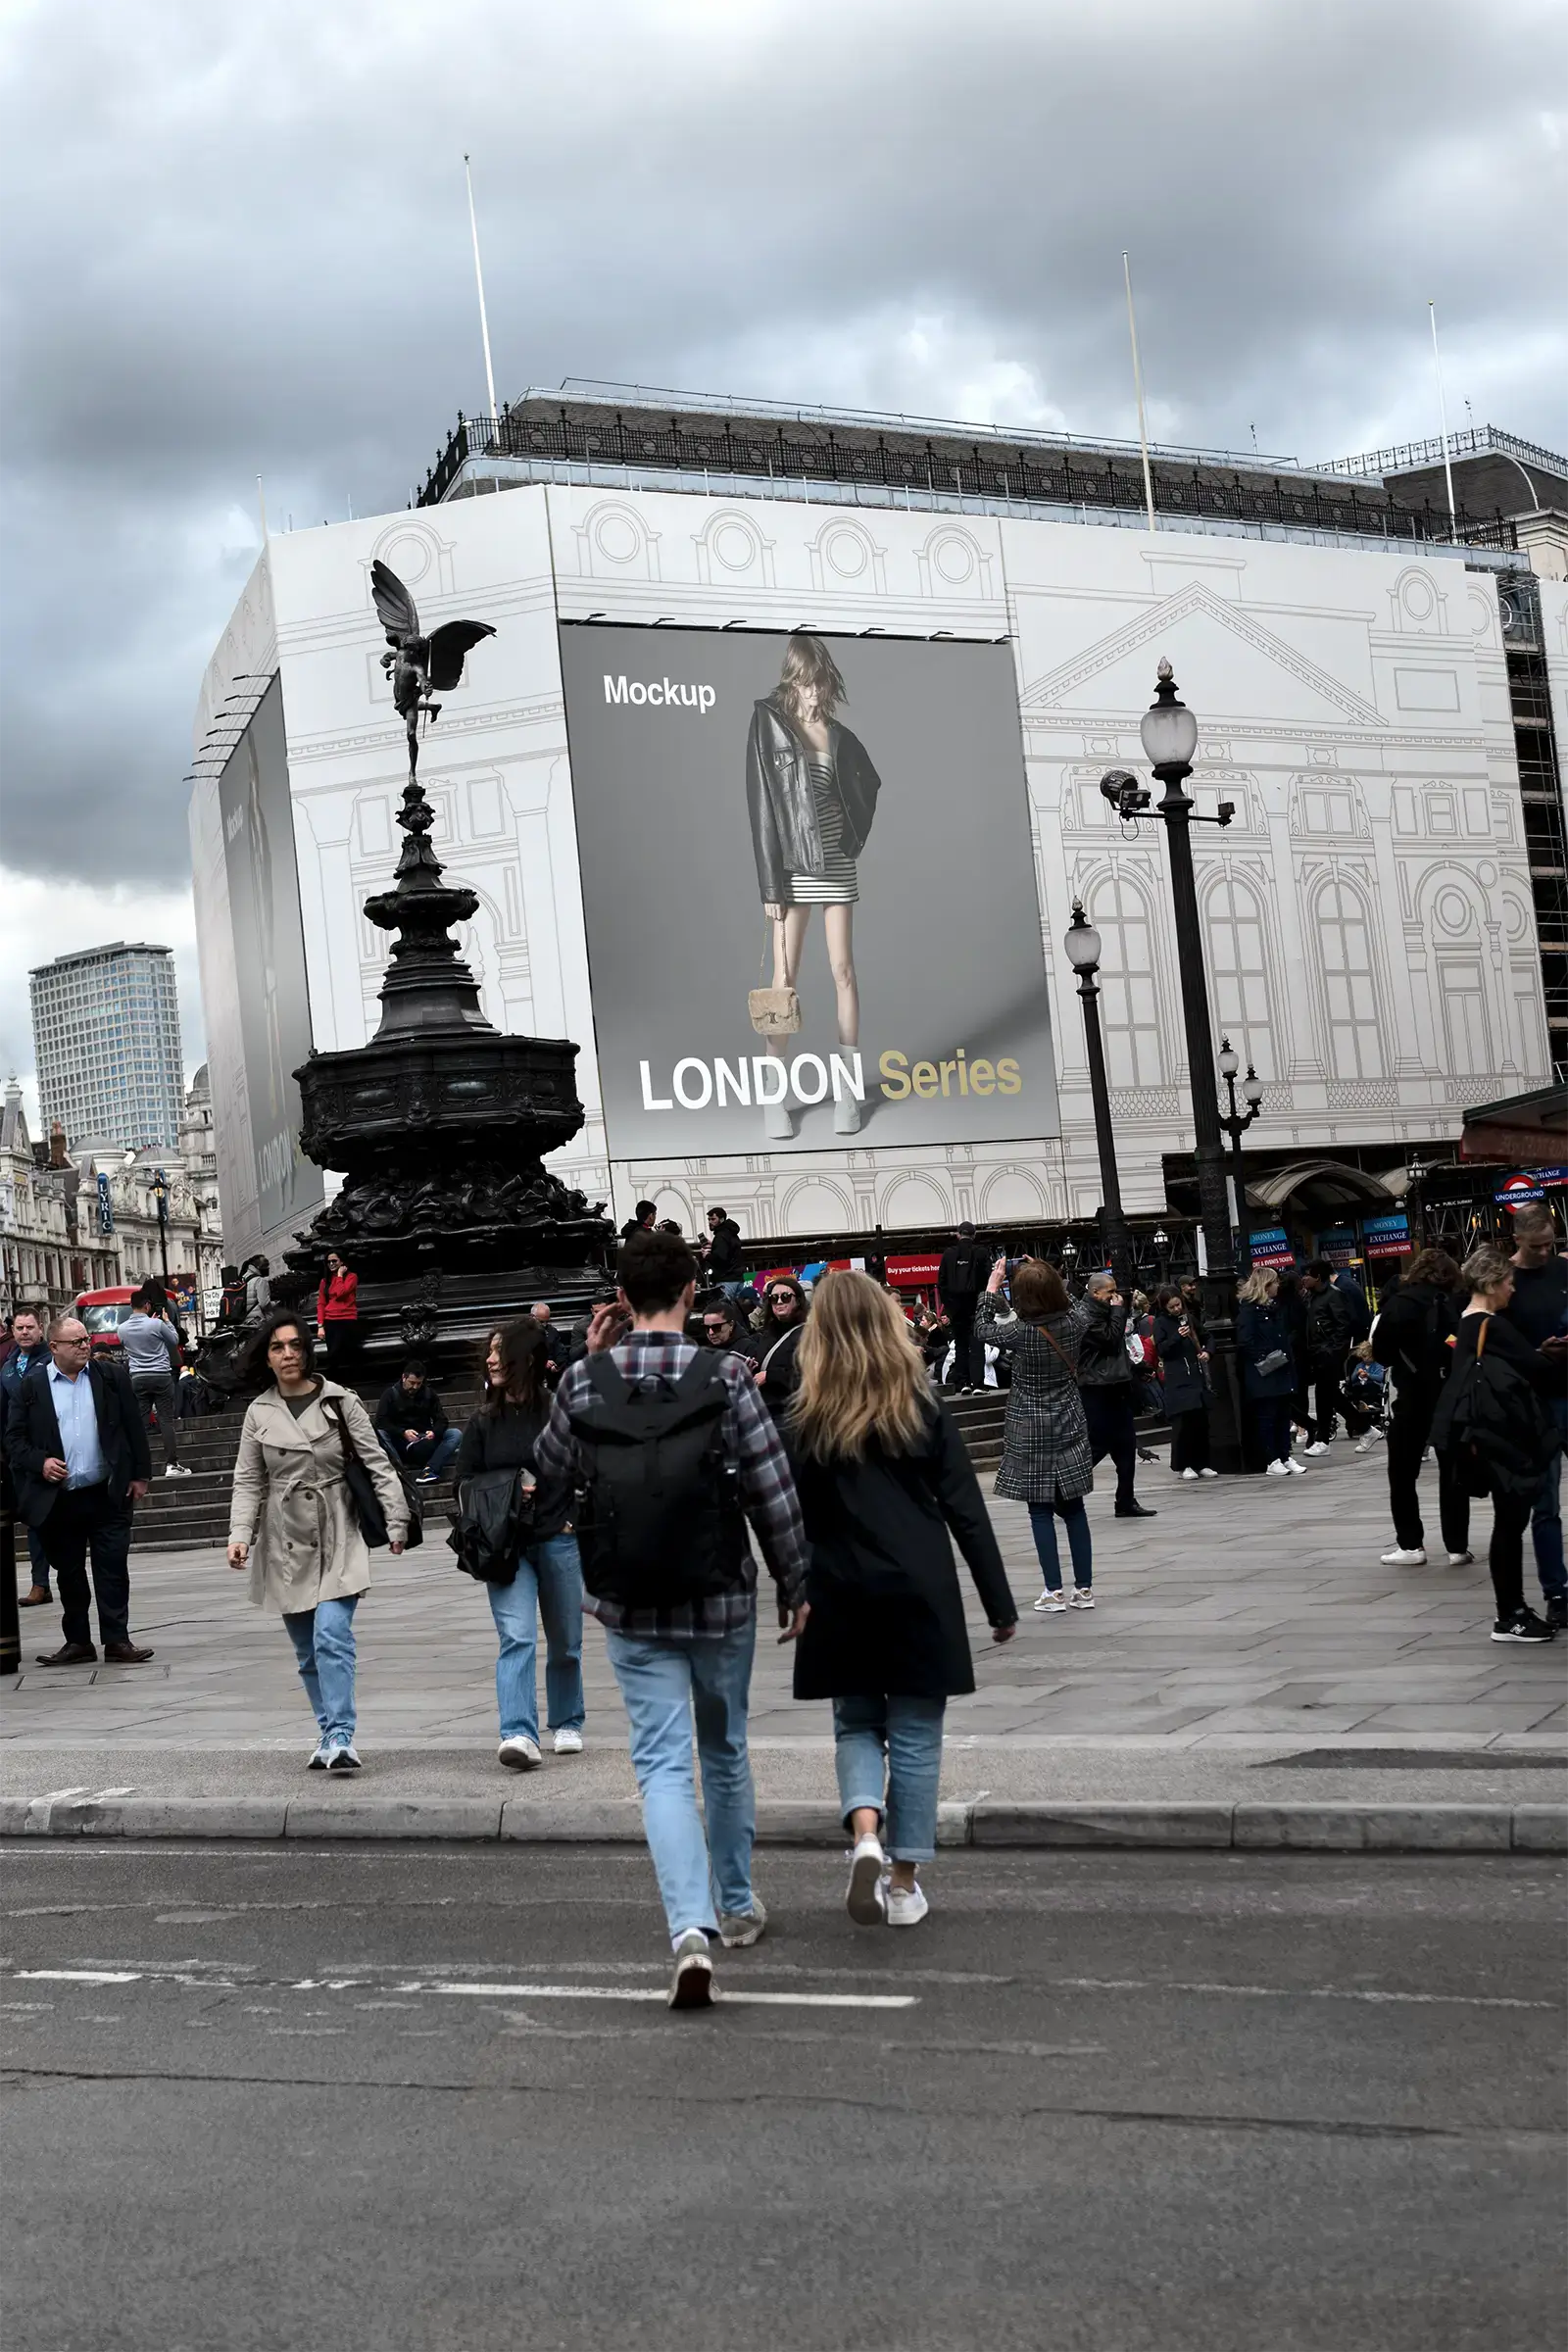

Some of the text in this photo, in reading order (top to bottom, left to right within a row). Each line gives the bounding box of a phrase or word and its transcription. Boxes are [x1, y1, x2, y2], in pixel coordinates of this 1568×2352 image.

[604, 675, 716, 713] Mockup
[226, 804, 243, 844] Mockup
[639, 1049, 1022, 1110] LONDON Series
[258, 1124, 293, 1193] LONDON
[99, 1183, 112, 1230] LYRIC
[1494, 1190, 1544, 1201] UNDERGROUND
[1252, 1232, 1276, 1242] MONEY
[1373, 1220, 1397, 1229] MONEY
[1250, 1243, 1288, 1255] EXCHANGE
[1369, 1231, 1406, 1244] EXCHANGE
